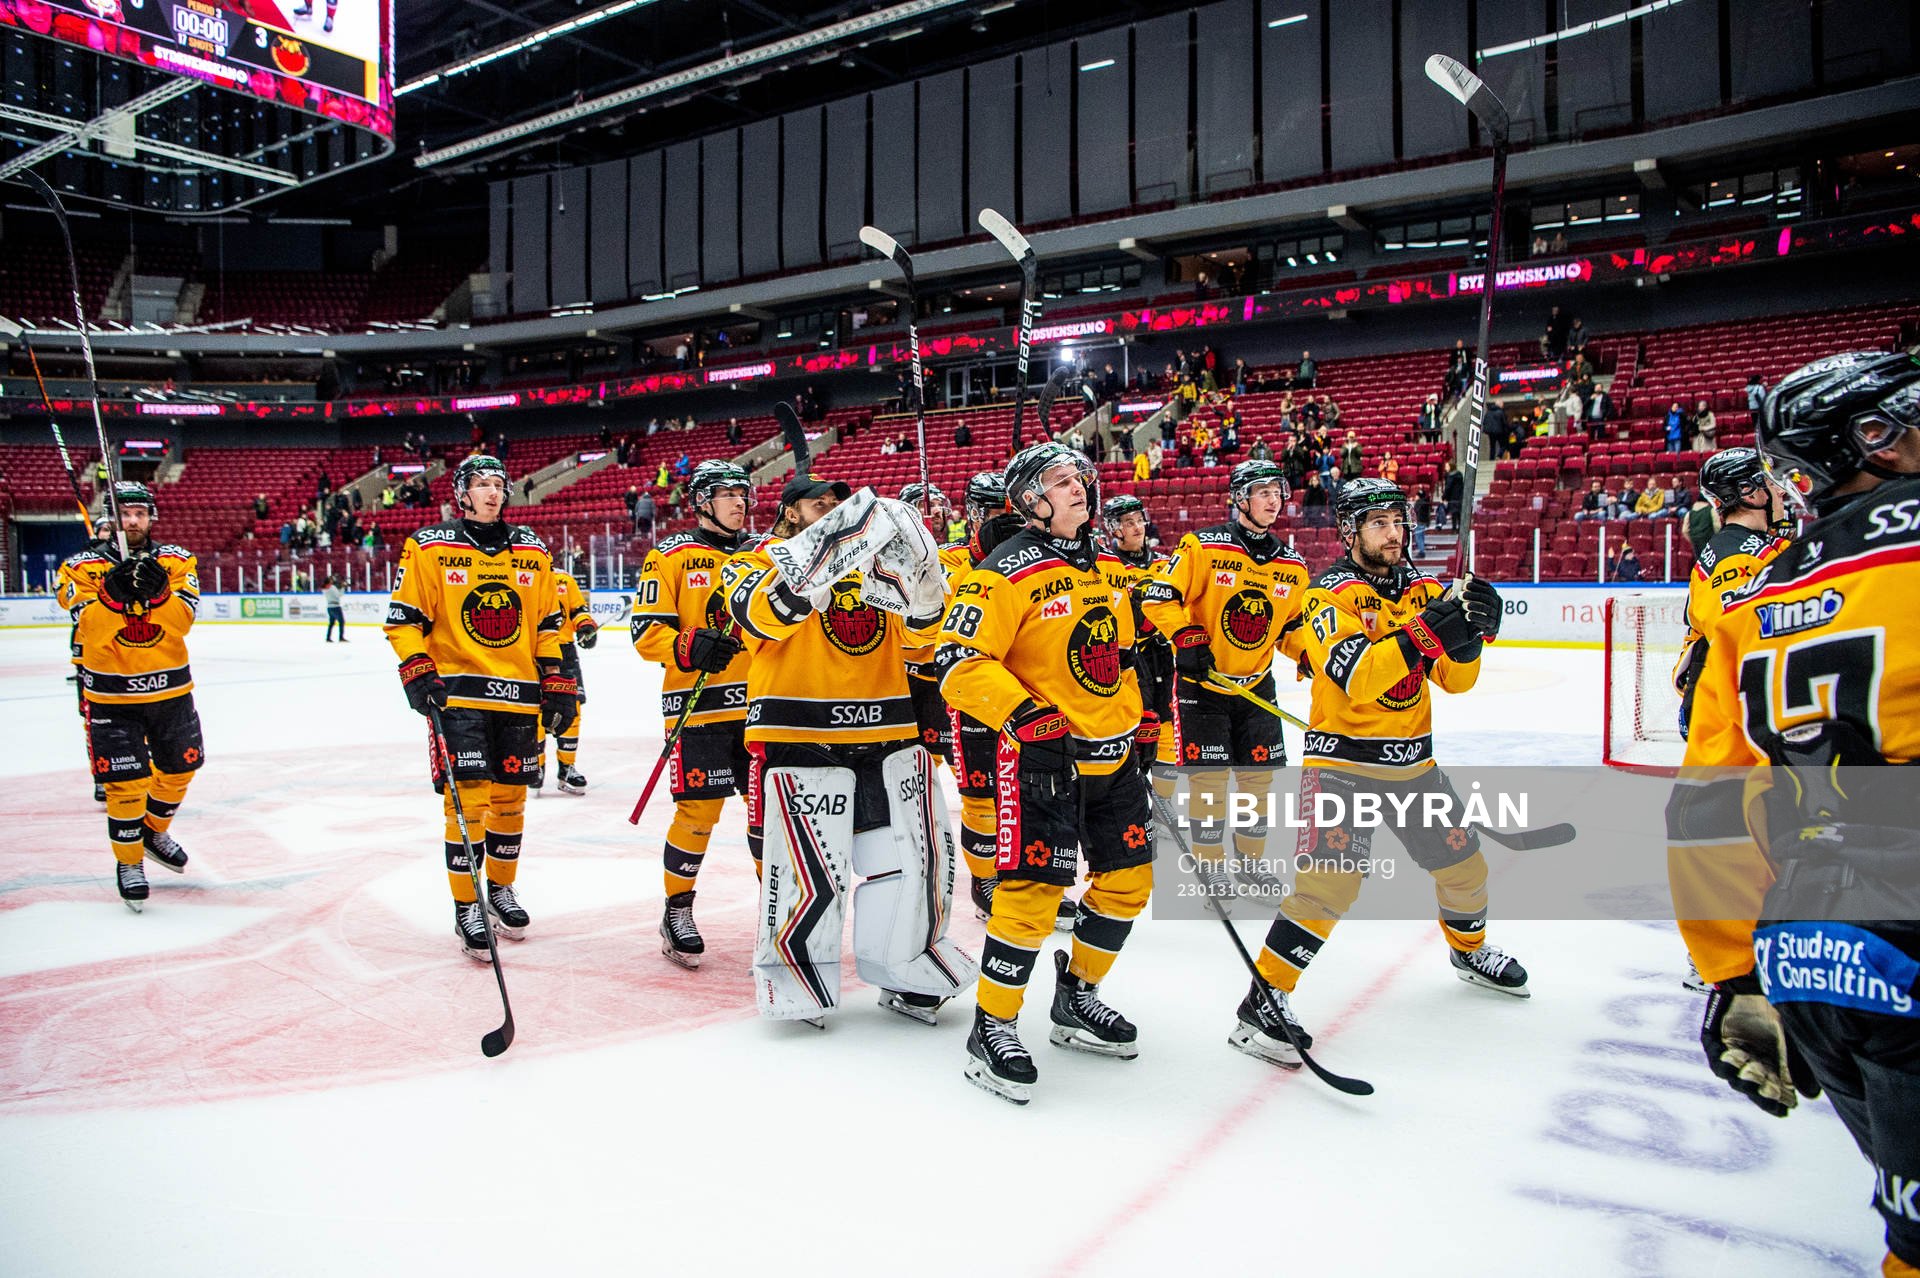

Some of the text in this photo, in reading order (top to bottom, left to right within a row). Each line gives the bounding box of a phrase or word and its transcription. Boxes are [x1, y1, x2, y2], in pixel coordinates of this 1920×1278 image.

[177, 10, 225, 43] 00:00
[255, 27, 268, 48] 3
[1460, 264, 1566, 290] SYDVENSKAN
[418, 530, 456, 543] SSAB
[658, 534, 695, 553] SSAB
[1199, 532, 1232, 542] SSAB
[445, 556, 472, 567] LKAB
[686, 558, 714, 570] LKAB
[829, 540, 869, 573] BAUER
[998, 546, 1043, 574] SSAB
[1217, 559, 1242, 572] LKAB
[771, 546, 808, 587] SSAB
[689, 573, 708, 587] MAX
[1045, 577, 1074, 600] LKAB
[1216, 574, 1233, 587] MAX
[1279, 573, 1299, 585] LKA
[592, 603, 622, 614] SUPER
[865, 594, 903, 613] BAUER
[1043, 600, 1068, 617] MAX
[1757, 588, 1843, 638] Vinab
[942, 603, 983, 639] 88
[1311, 606, 1337, 645] 67
[1070, 650, 1085, 680] LULEÅ
[126, 674, 169, 692] SSAB
[485, 681, 520, 700] SSAB
[1739, 626, 1885, 760] 17
[830, 705, 882, 724] SSAB
[1379, 741, 1423, 763] SSAB
[708, 767, 732, 777] Luleå
[901, 773, 927, 802] SSAB
[789, 793, 848, 816] SSAB
[117, 827, 142, 838] NEX
[1200, 829, 1223, 840] NEX
[496, 844, 521, 855] NEX
[767, 864, 779, 928] BAUER
[1778, 931, 1864, 966] Student
[986, 957, 1025, 979] NEX
